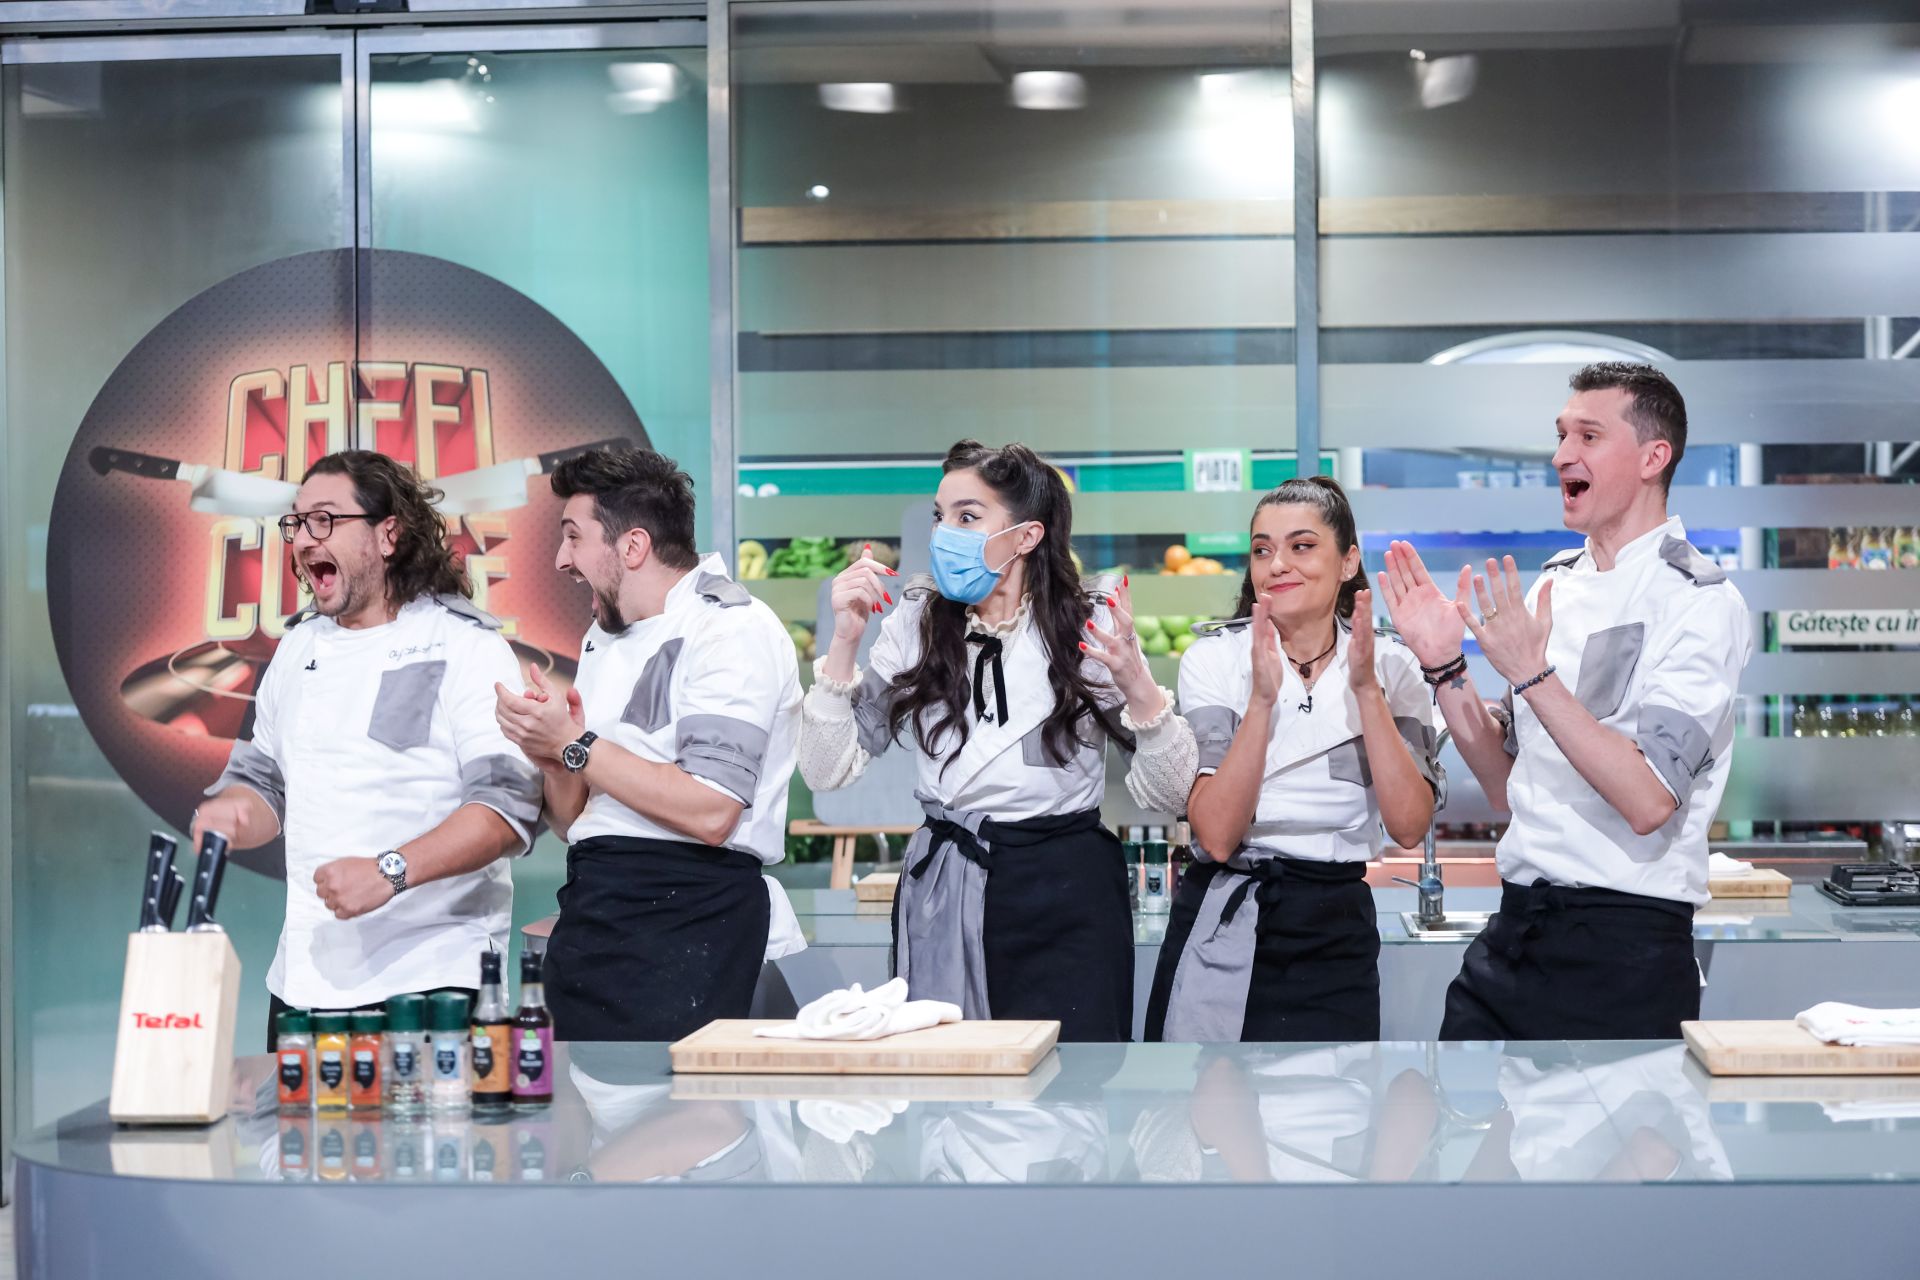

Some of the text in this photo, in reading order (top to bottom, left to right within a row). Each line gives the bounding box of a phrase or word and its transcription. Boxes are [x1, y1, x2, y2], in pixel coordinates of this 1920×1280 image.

[224, 361, 496, 482] CHEFI
[1876, 615, 1900, 632] cu
[132, 1013, 203, 1029] Tefal
